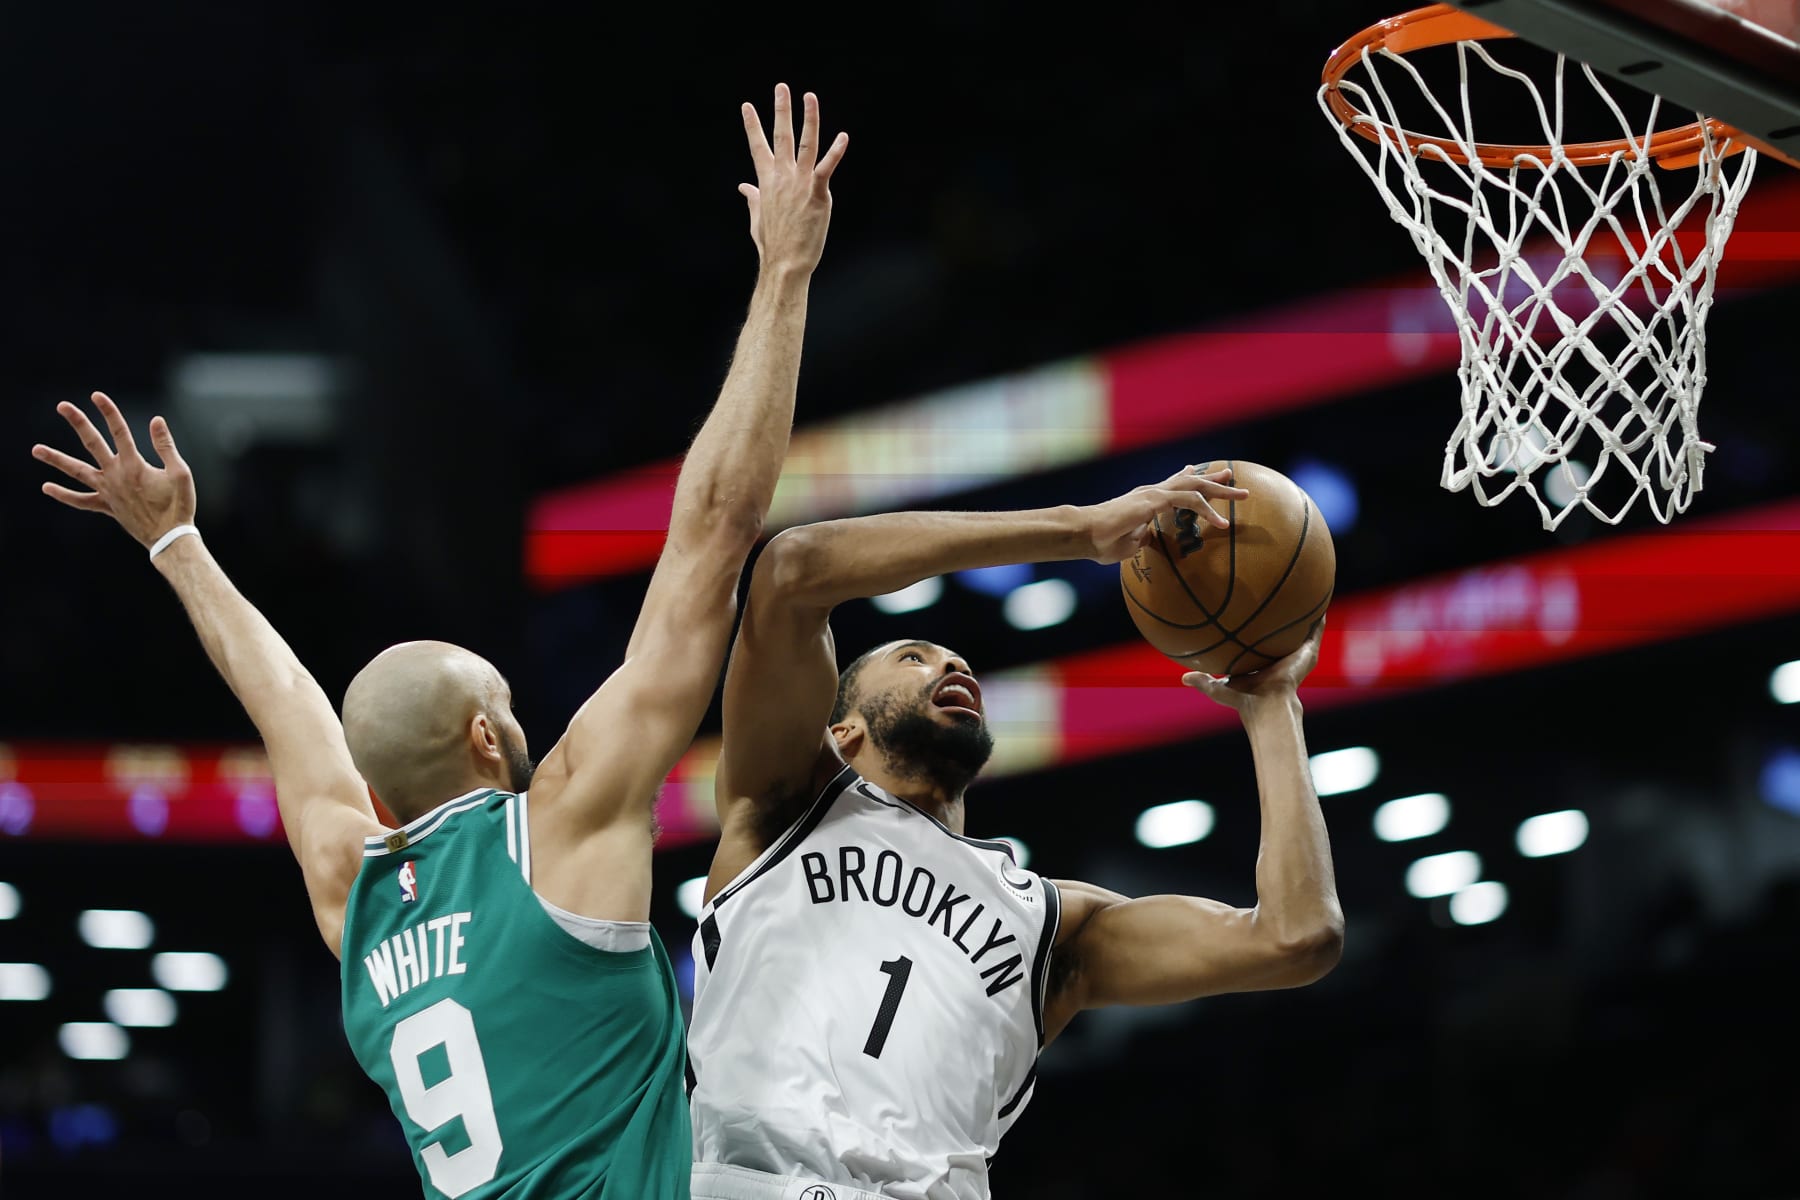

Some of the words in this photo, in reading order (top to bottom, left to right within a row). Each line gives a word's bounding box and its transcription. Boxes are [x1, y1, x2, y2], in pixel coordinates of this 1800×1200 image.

[364, 912, 471, 1007] WHITE
[801, 846, 1024, 998] BROOKLYN
[862, 955, 913, 1059] 1
[390, 998, 503, 1199] 9
